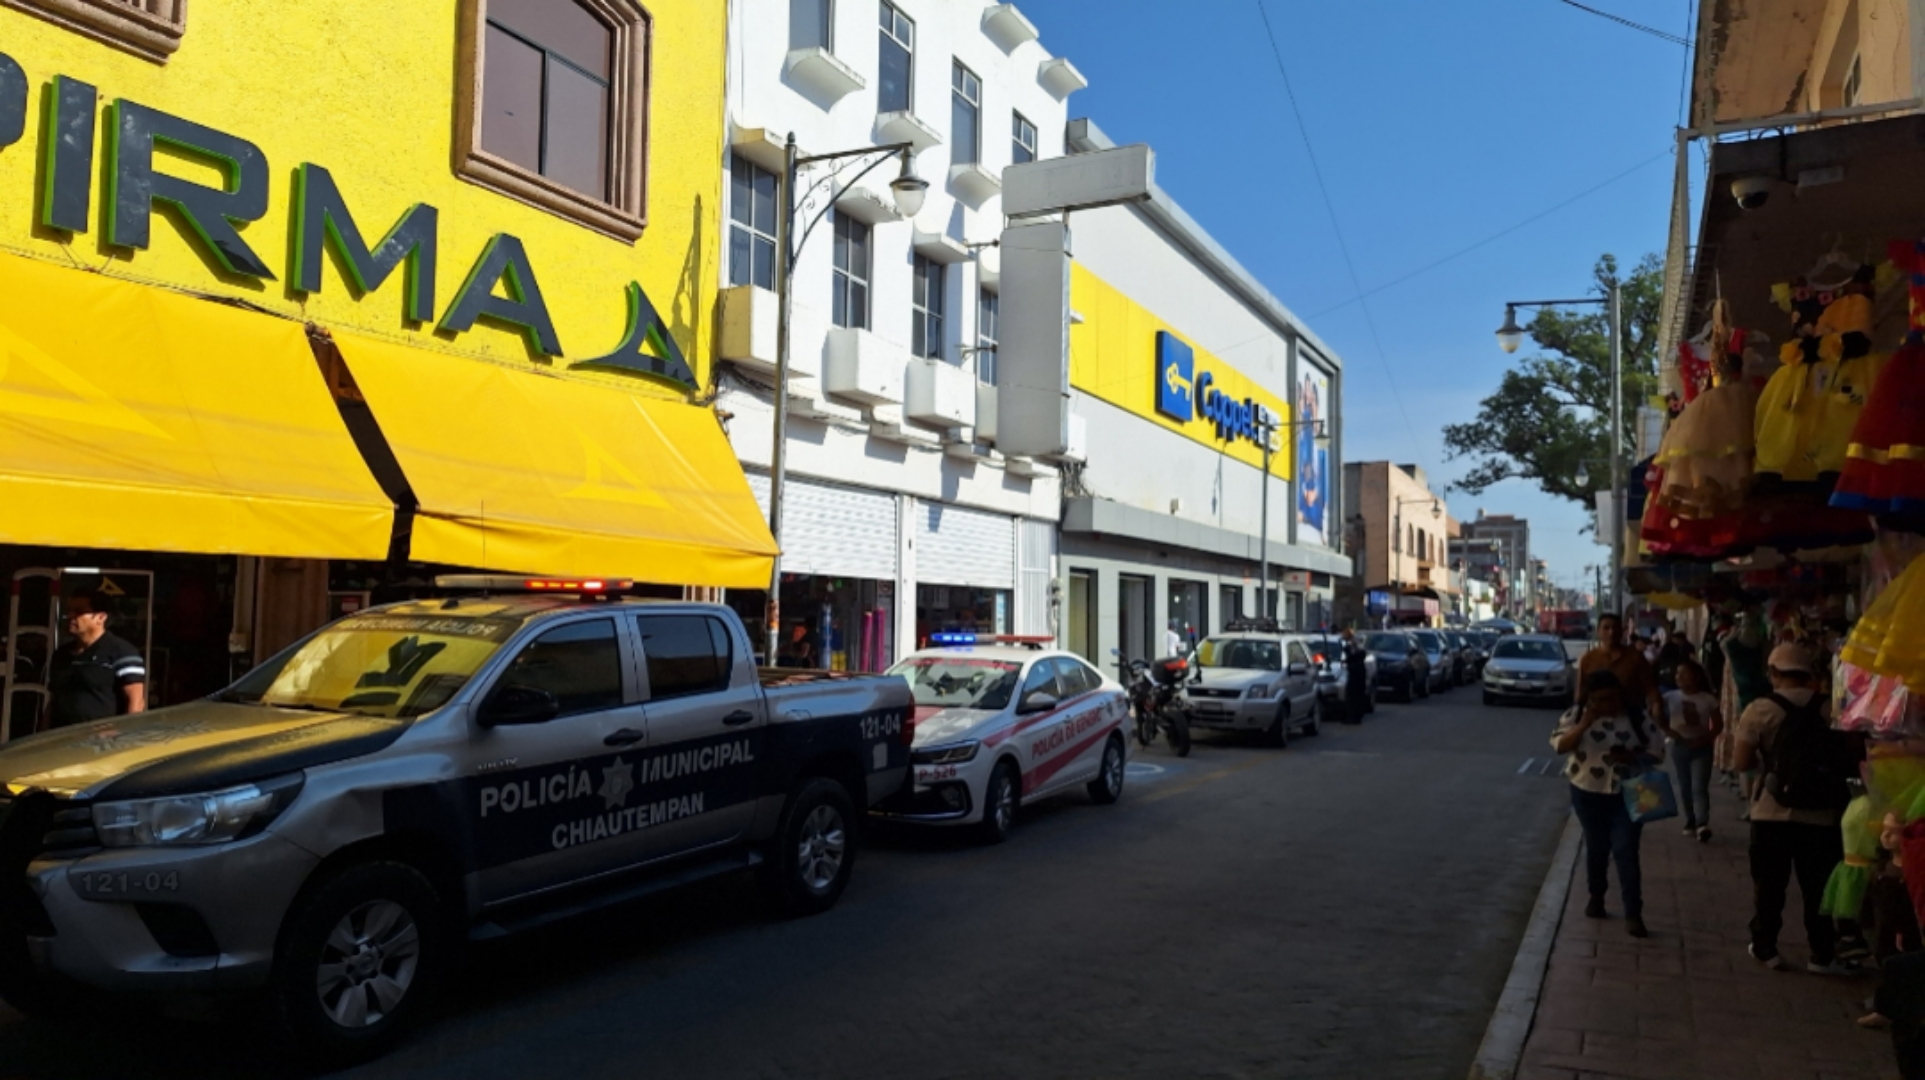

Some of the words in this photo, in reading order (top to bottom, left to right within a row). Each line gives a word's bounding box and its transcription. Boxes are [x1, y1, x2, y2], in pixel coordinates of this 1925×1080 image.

[0, 51, 563, 359] IRMA
[859, 713, 901, 740] 121-04
[480, 766, 592, 817] POLICÍA
[641, 739, 754, 784] MUNICIPAL
[919, 765, 956, 781] P-526
[552, 791, 704, 849] CHIAUTEMPAN
[82, 869, 179, 892] 121-04
